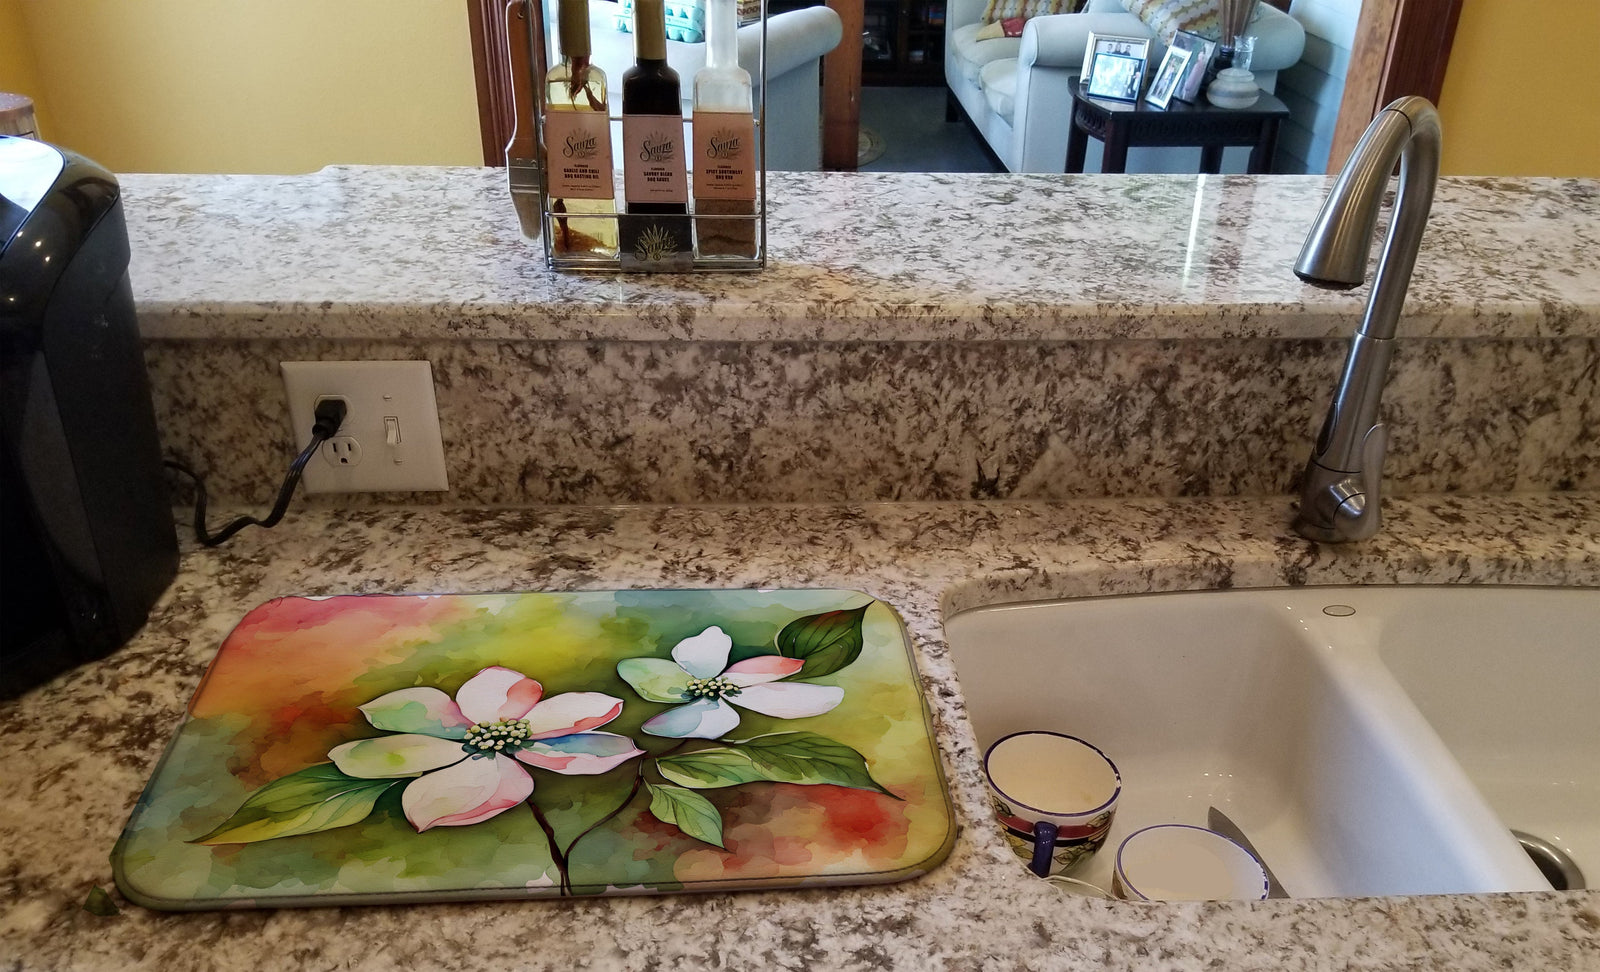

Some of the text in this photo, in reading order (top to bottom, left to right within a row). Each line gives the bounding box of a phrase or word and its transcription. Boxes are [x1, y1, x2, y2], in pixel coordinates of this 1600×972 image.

[563, 136, 597, 158] Sauza
[640, 140, 673, 162] Sauza
[707, 137, 740, 159] Sauza
